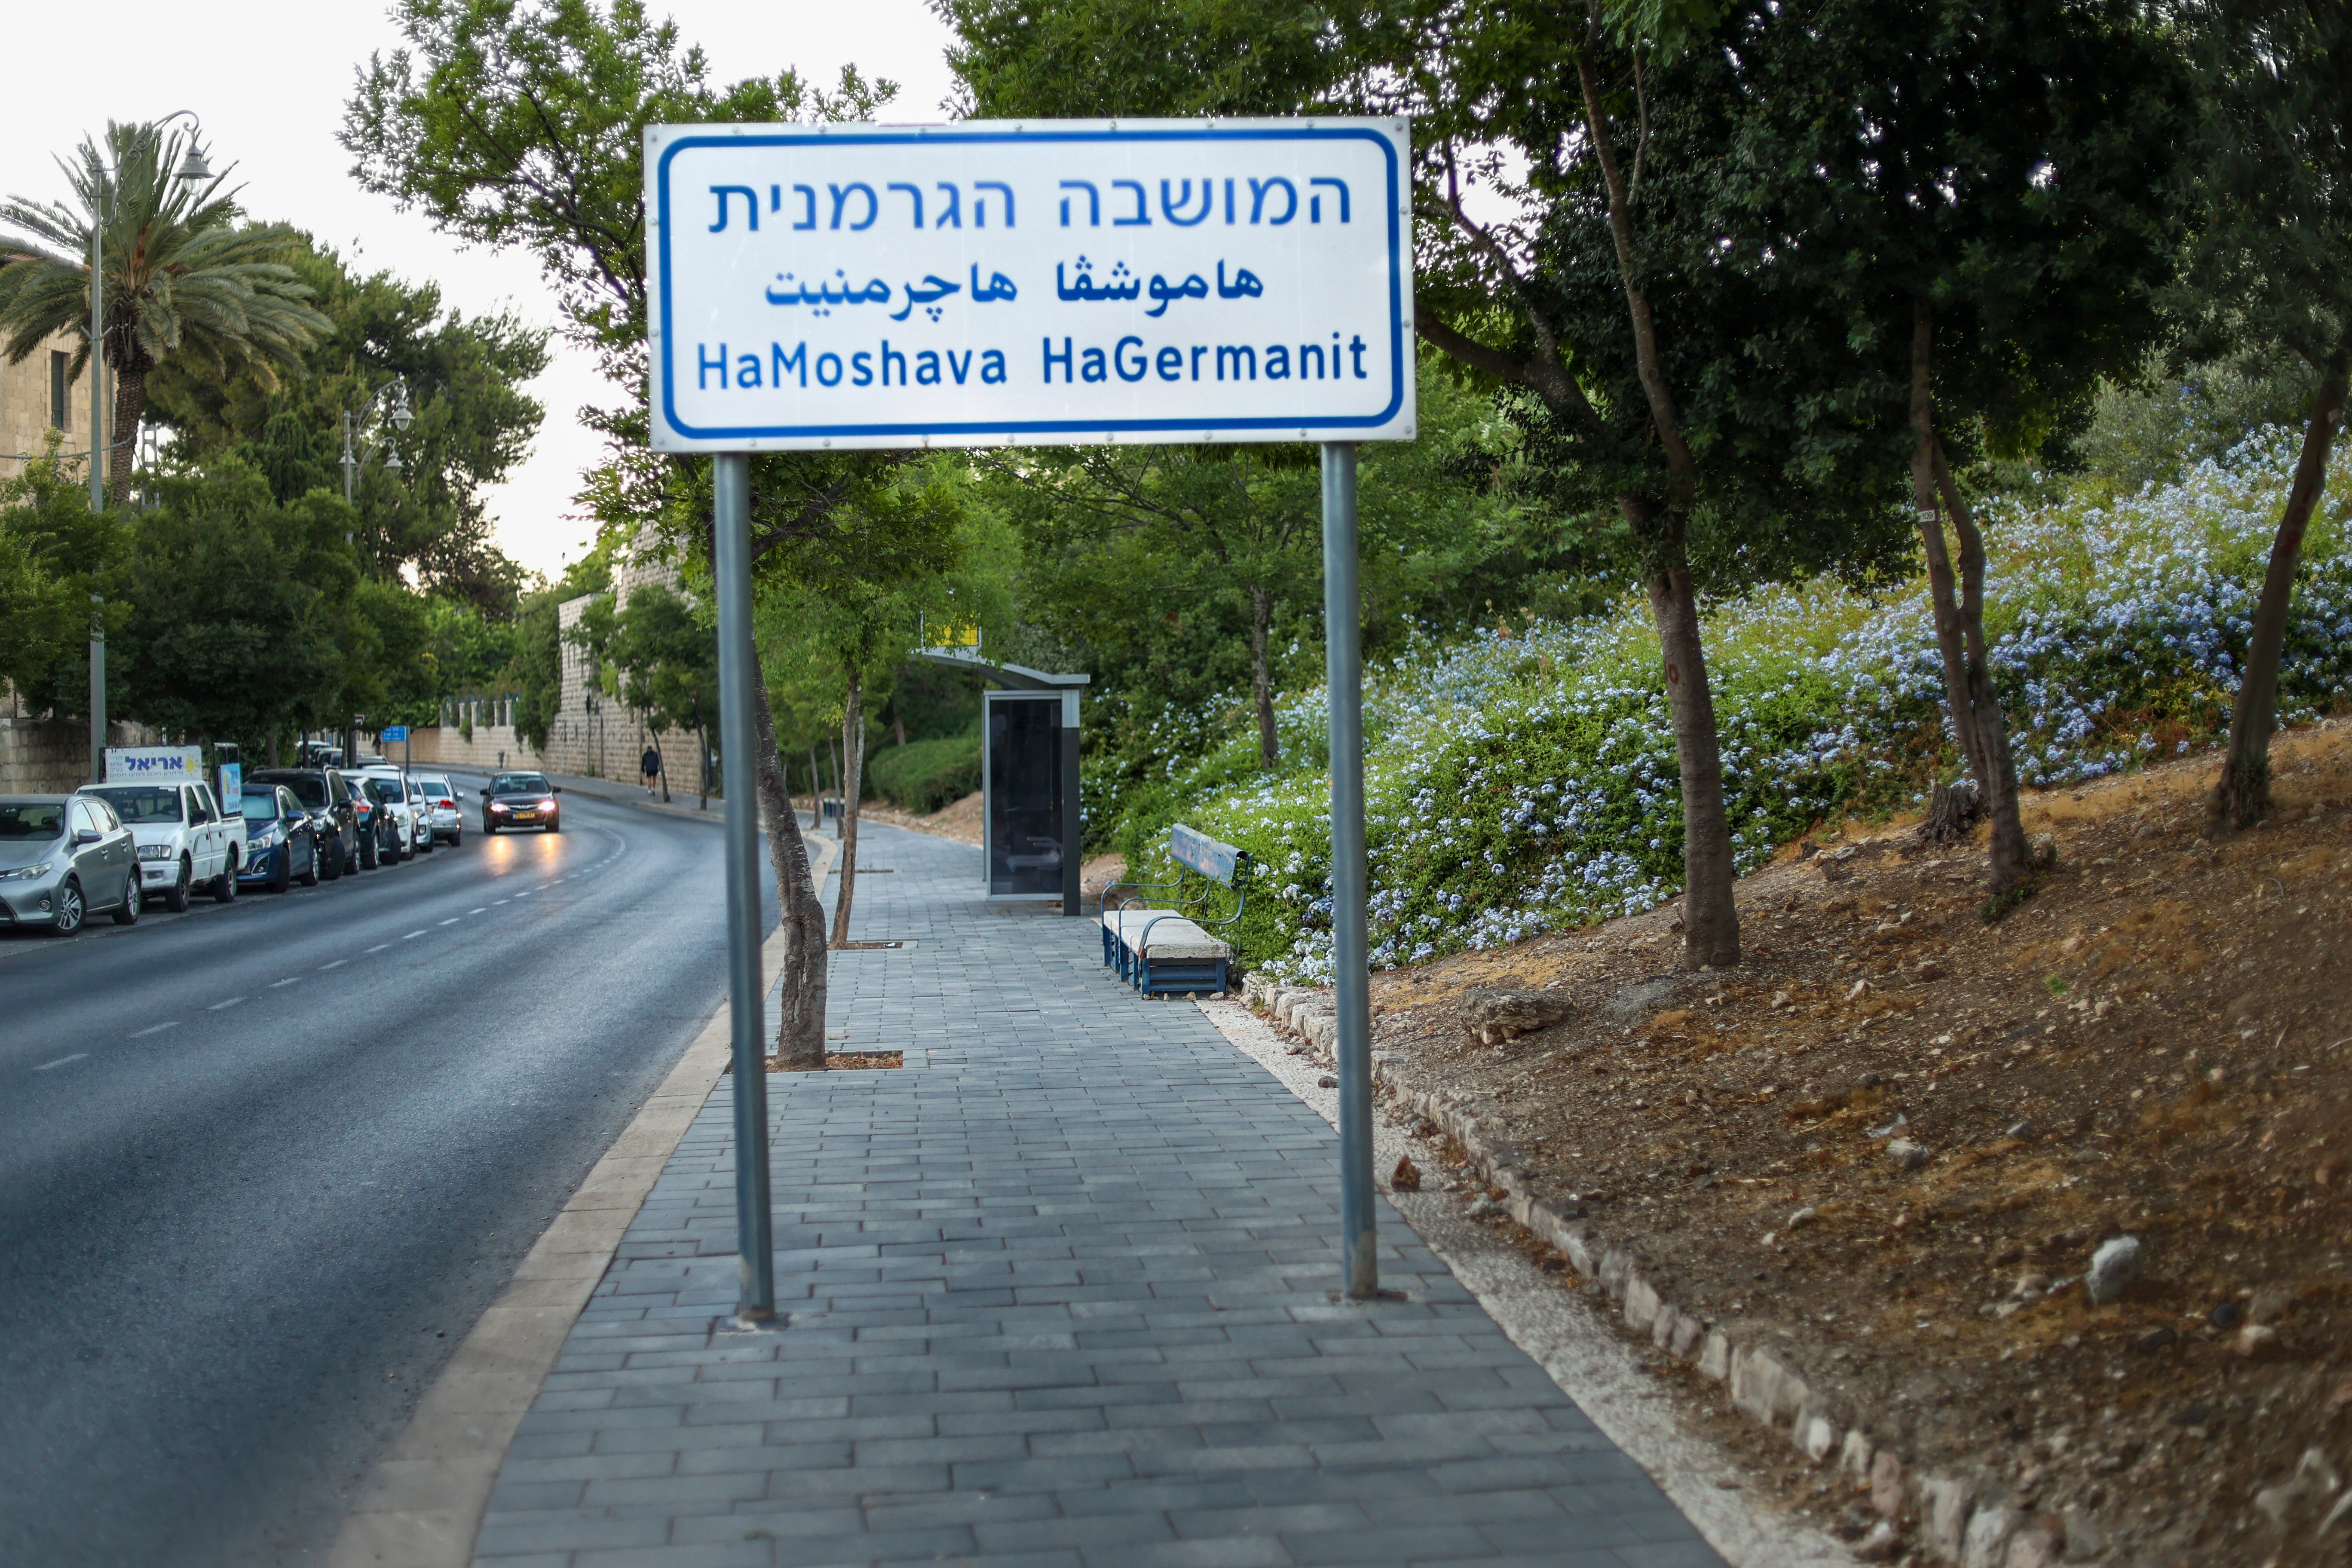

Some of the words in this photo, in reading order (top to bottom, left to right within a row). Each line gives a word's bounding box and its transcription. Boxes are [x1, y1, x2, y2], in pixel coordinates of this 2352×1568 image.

[708, 181, 1015, 233] הגרמנית
[1060, 177, 1351, 227] המושבה
[765, 262, 1018, 322] هاچرمنيت
[1057, 254, 1264, 318] هاموشڤا
[698, 339, 1007, 390] HaMoshava
[1042, 332, 1367, 384] HaGermanit
[1923, 511, 1933, 520] 109
[125, 756, 183, 771] אריאל
